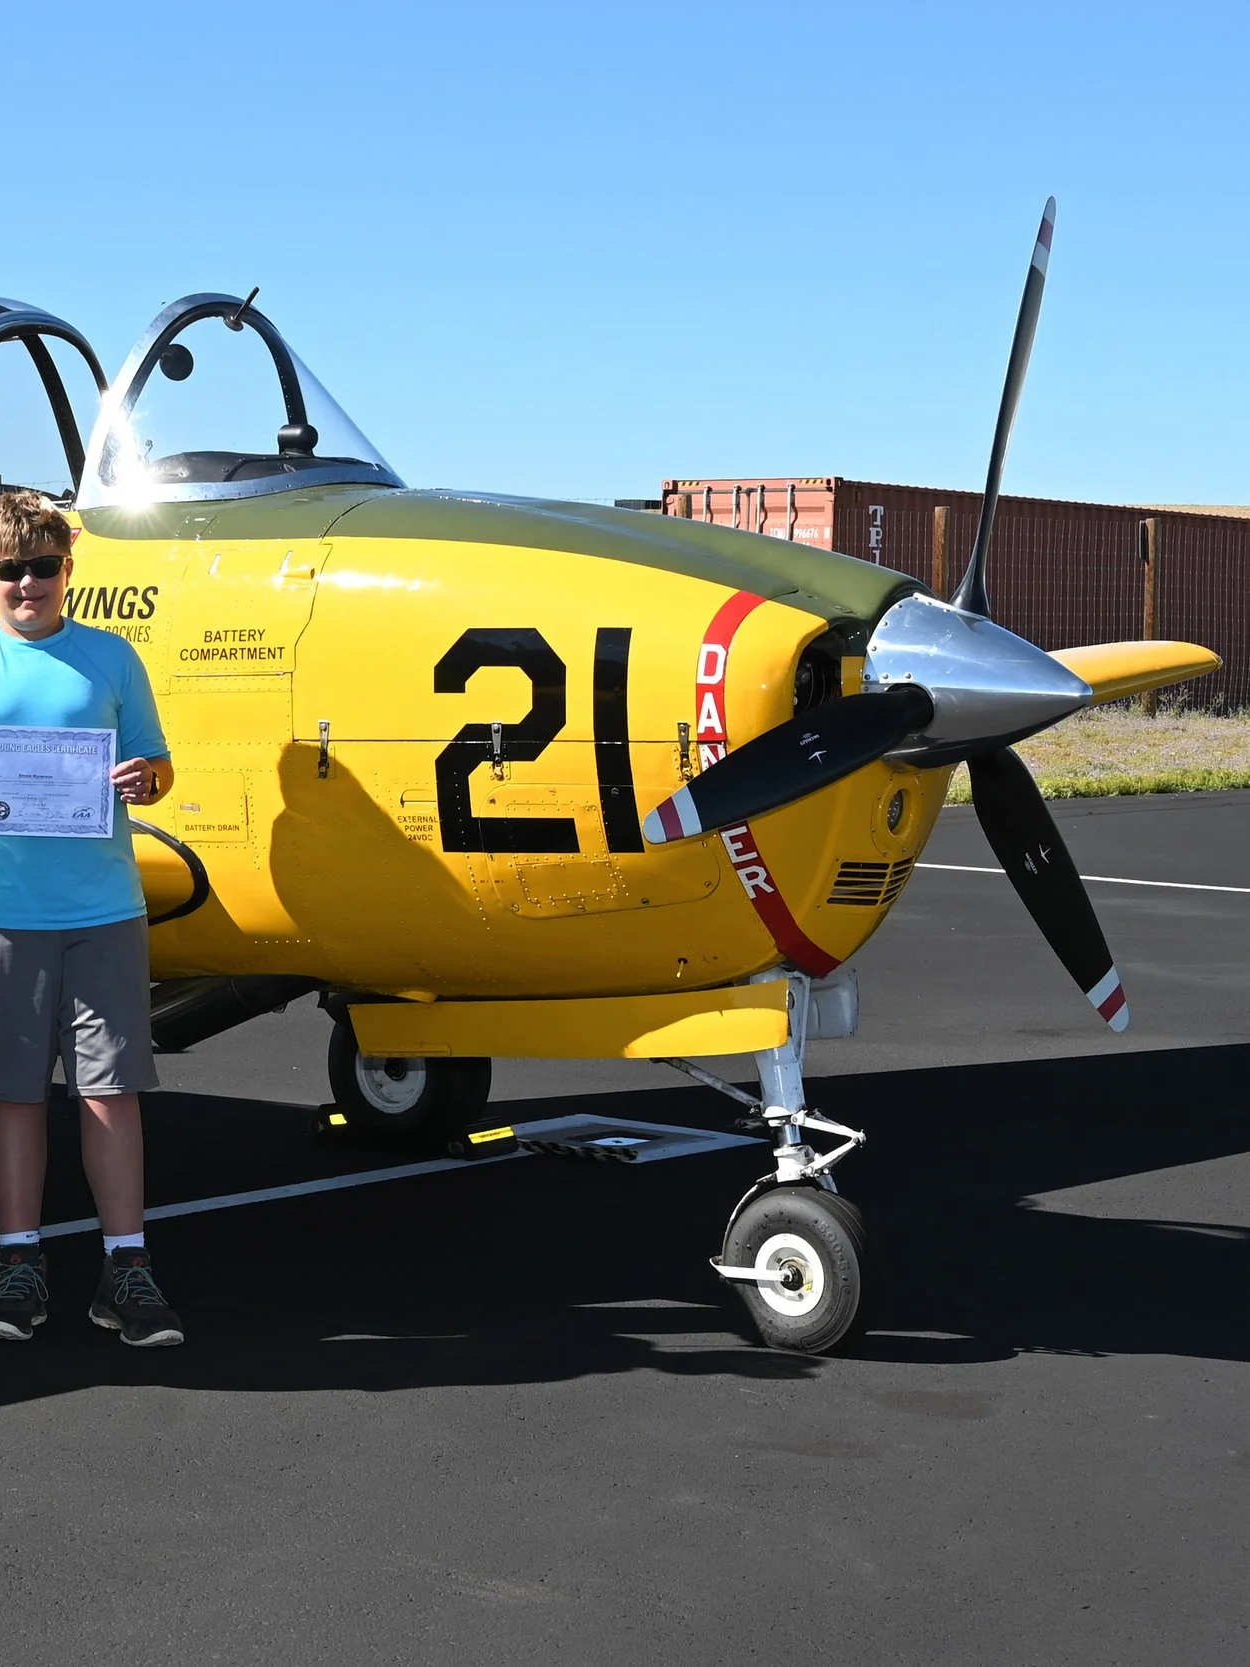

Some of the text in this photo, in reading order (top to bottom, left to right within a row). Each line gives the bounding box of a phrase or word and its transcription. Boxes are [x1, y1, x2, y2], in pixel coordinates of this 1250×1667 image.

[203, 628, 266, 643] BATTERY
[179, 646, 286, 661] COMPARTMENT
[434, 626, 645, 854] 21
[22, 744, 51, 753] EAGLES
[52, 745, 98, 754] CERTIFICATE
[696, 642, 775, 900] DANER
[397, 815, 438, 823] EXTERNAL
[184, 824, 240, 832] BATTERY DRAIN
[404, 824, 434, 832] POWER
